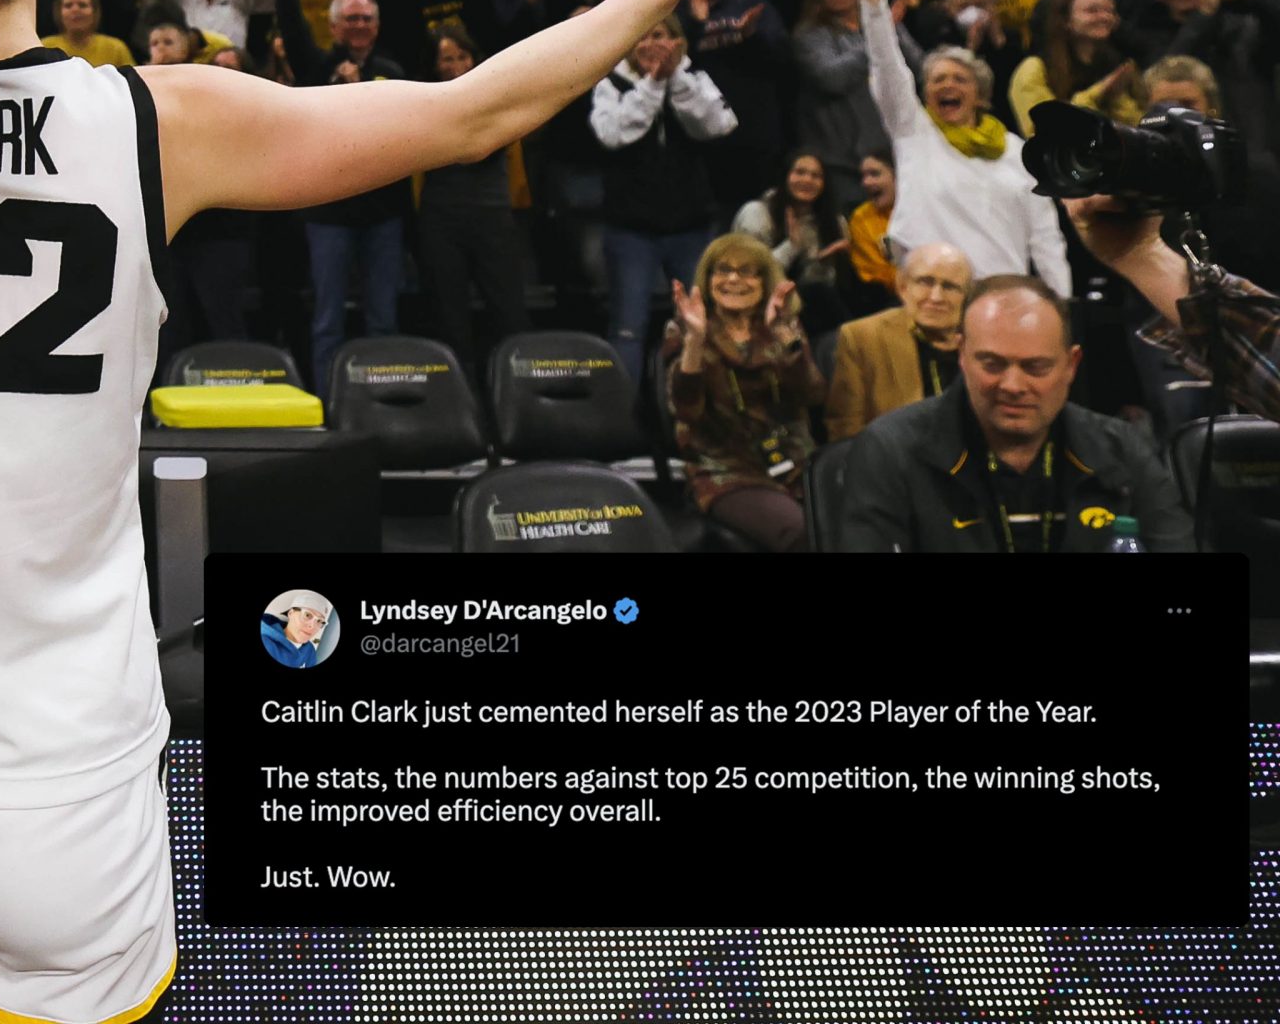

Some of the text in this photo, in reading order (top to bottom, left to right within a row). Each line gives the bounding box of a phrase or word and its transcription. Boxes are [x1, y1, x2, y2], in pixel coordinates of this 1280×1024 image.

[516, 508, 590, 525] UNIVERSITY
[603, 505, 643, 520] IOWA
[520, 521, 612, 540] HEALTH CARE
